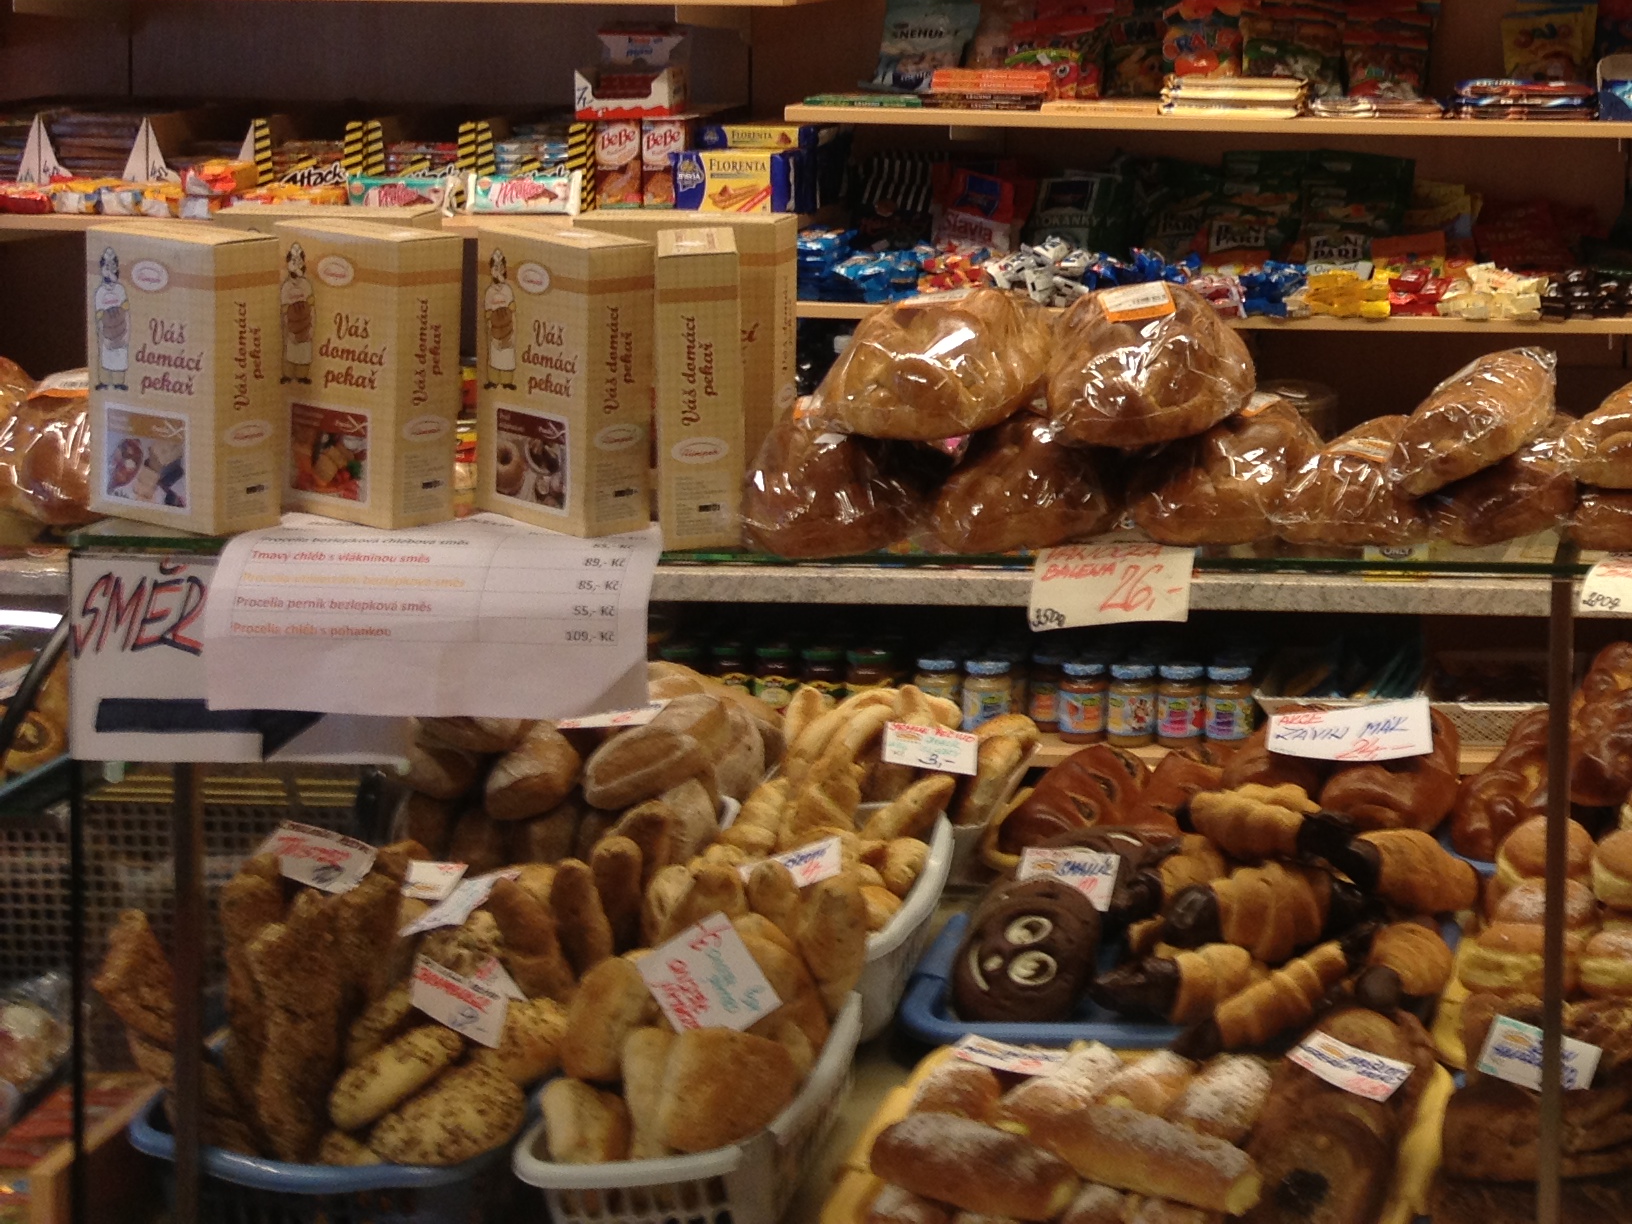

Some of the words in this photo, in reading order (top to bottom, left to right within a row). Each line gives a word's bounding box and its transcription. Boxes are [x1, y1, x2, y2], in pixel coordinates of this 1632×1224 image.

[601, 128, 637, 151] BeBe
[646, 128, 681, 151] BeBe
[731, 130, 773, 141] FLORENTA
[709, 158, 768, 174] FLORENTA
[946, 213, 993, 242] Slavia
[149, 318, 186, 345] Váš
[235, 301, 247, 370] domácí
[334, 312, 371, 340] Váš
[416, 298, 429, 365] domácí
[533, 319, 564, 347] Váš
[605, 306, 619, 375] domácí
[135, 343, 204, 372] domácí
[250, 326, 264, 380] pekař
[319, 338, 387, 367] domácí
[429, 323, 442, 376] pekař
[522, 344, 578, 375] domácí
[623, 330, 635, 385] pekař
[684, 315, 696, 383] domácí
[141, 372, 196, 396] pekař
[324, 366, 378, 390] pekař
[702, 342, 718, 397] pekař
[234, 372, 251, 410] Váš
[413, 368, 428, 407] Váš
[527, 372, 573, 398] pekař
[604, 378, 619, 415] Váš
[682, 389, 700, 428] Váš
[293, 550, 325, 562] chléb
[328, 554, 335, 562] s
[338, 551, 397, 563] vlákninou
[400, 552, 431, 564] směs
[611, 556, 626, 568] Kč
[605, 579, 619, 590] Kč
[236, 596, 284, 609] Procelia
[287, 597, 325, 611] perník
[329, 598, 398, 612] bezlepková
[401, 600, 432, 612] směs
[601, 604, 615, 616] Kč
[233, 621, 281, 634] Procelia
[285, 622, 317, 635] chléb
[330, 624, 392, 638] pohankou
[565, 630, 597, 642] 109,-
[601, 630, 615, 642] Kč
